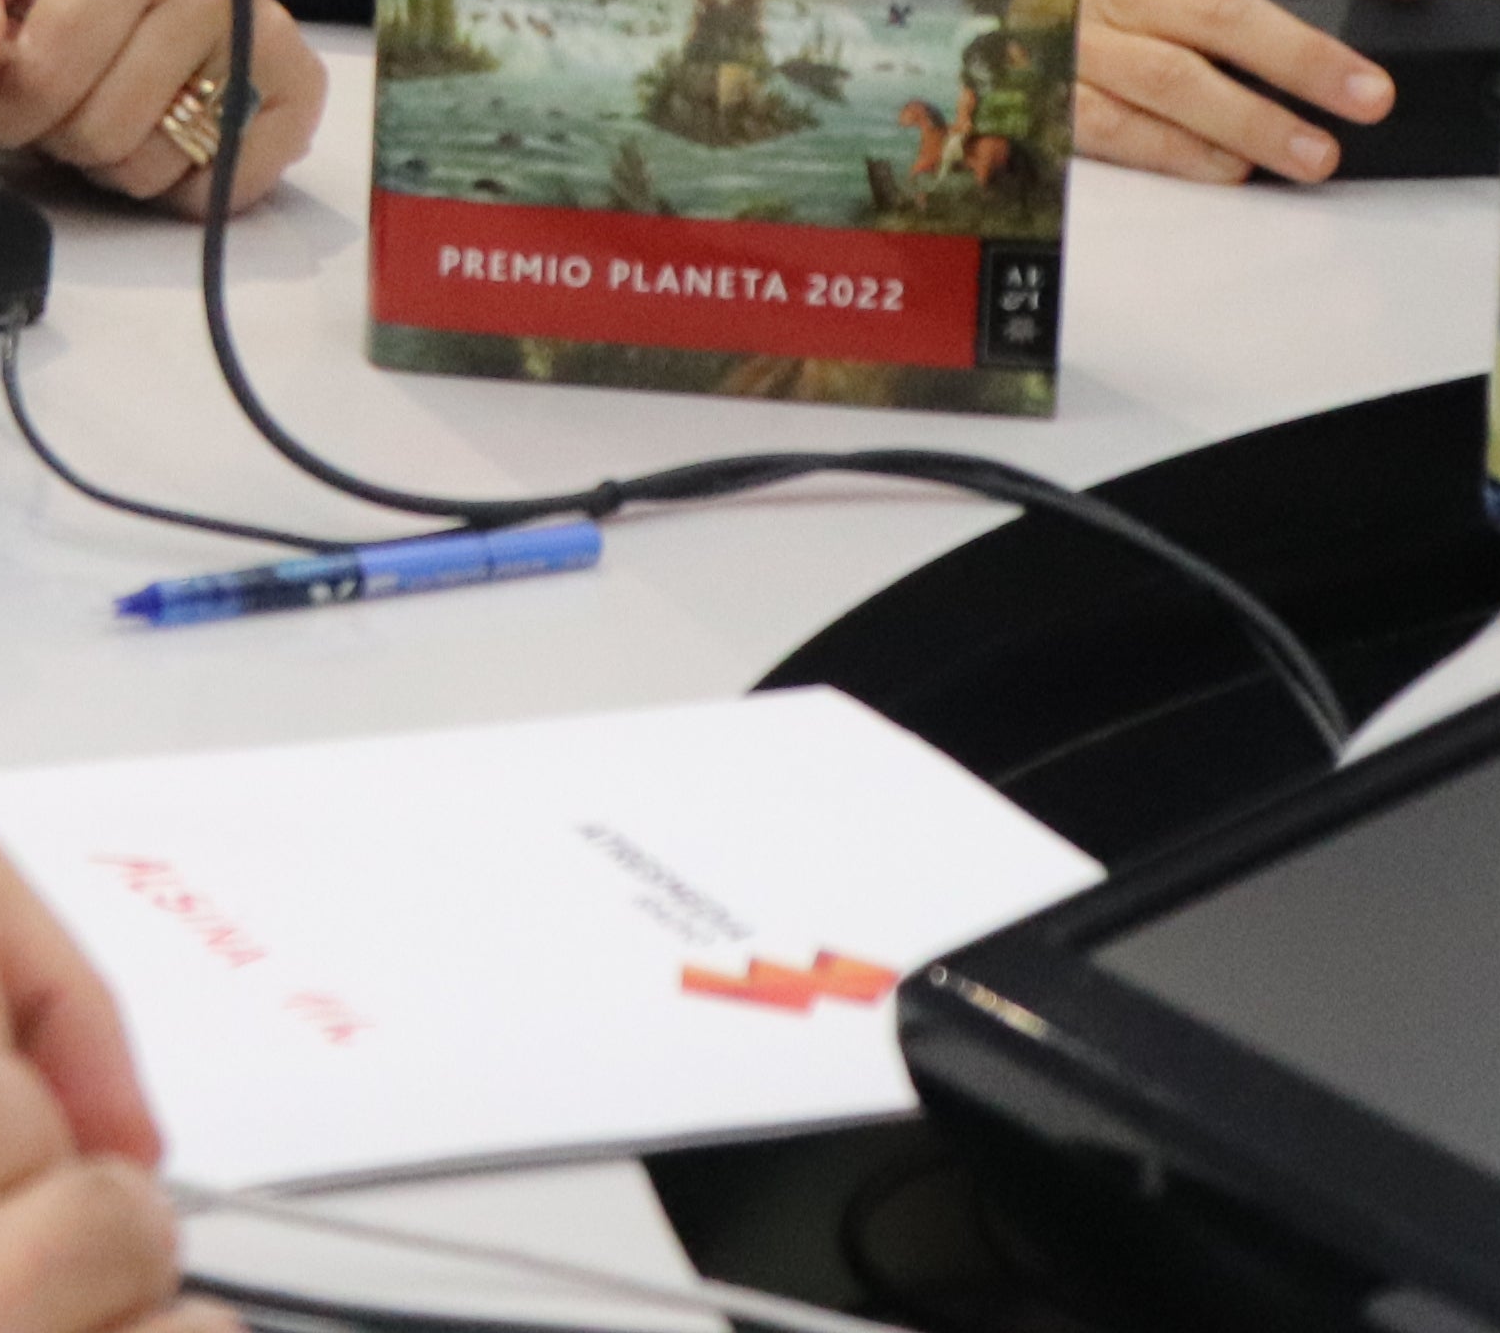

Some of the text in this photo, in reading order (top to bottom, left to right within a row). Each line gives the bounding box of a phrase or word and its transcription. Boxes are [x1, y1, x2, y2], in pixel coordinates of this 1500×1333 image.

[438, 244, 905, 312] PREMIO PLANETA 2022
